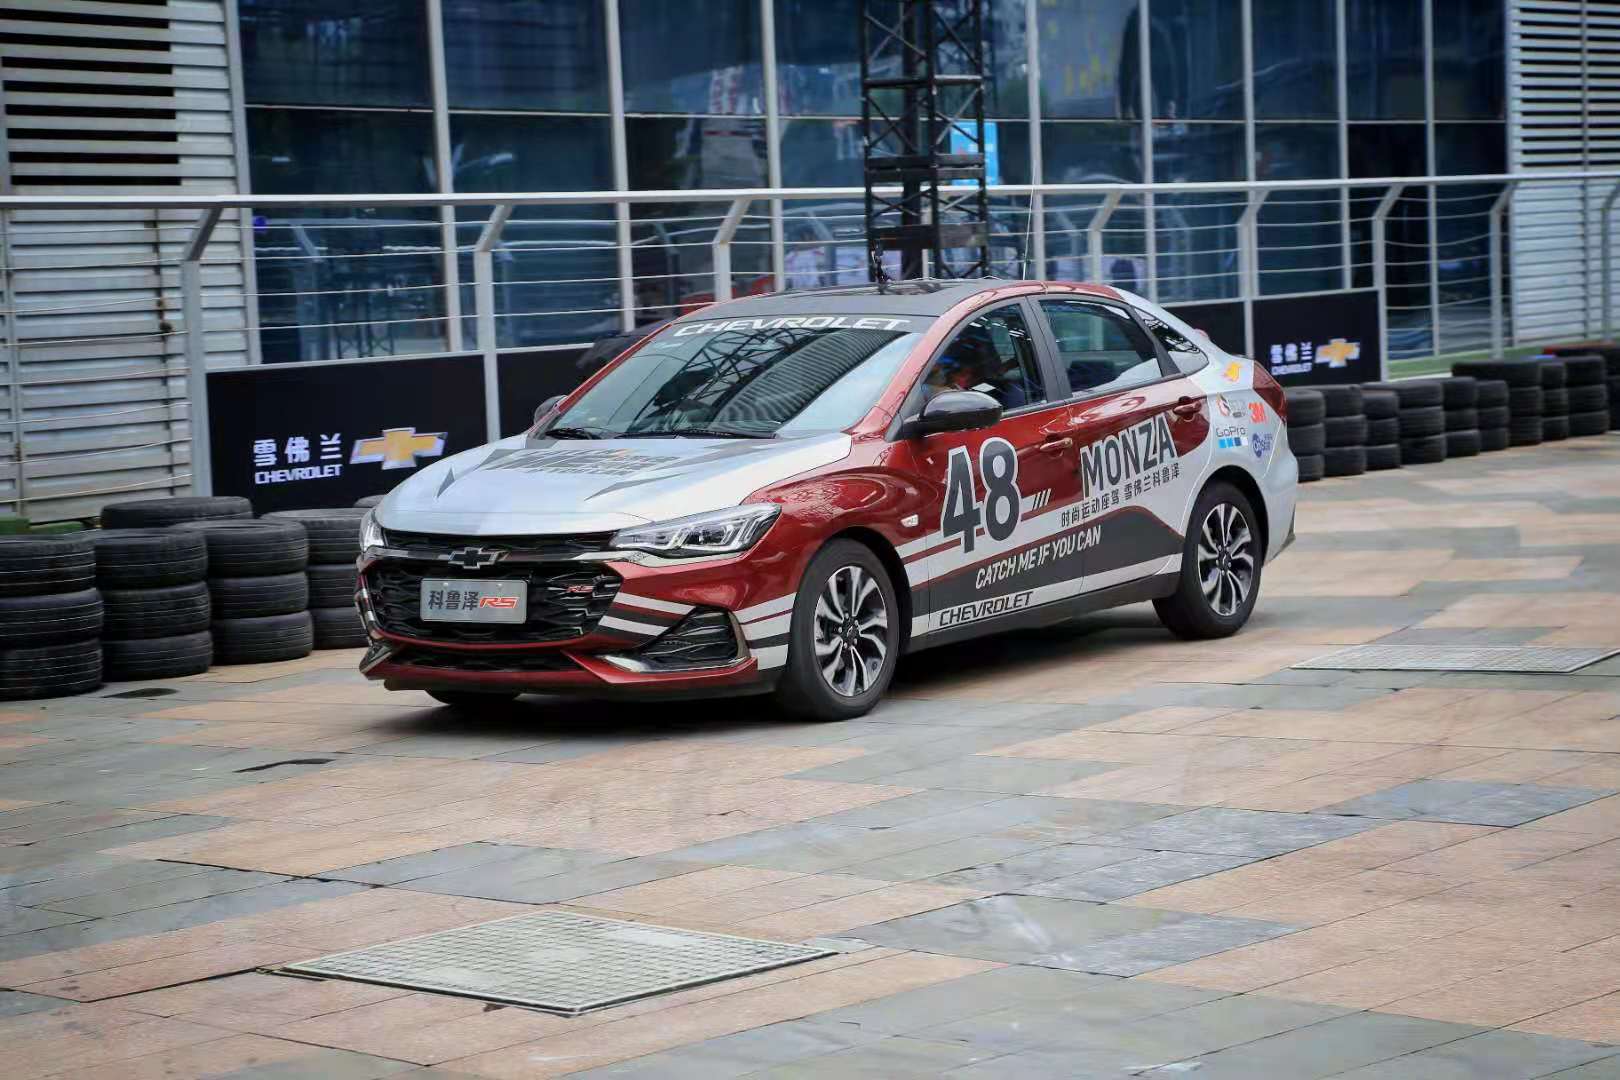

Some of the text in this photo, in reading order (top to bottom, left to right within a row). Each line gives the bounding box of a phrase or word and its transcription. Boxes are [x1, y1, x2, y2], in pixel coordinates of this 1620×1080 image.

[673, 316, 911, 337] CHEVROLET
[1216, 426, 1246, 437] GoPro
[253, 433, 343, 466] 雪佛兰
[1080, 412, 1178, 498] MONZA
[254, 464, 343, 485] CHEVROLET
[941, 437, 1021, 553] 48
[1061, 489, 1119, 527] 时尚运动座驾
[975, 525, 1102, 590] CATCH ME IF YOU CAN
[428, 590, 520, 611] 科鲁泽 RS
[940, 591, 1034, 626] CHEVROLET
